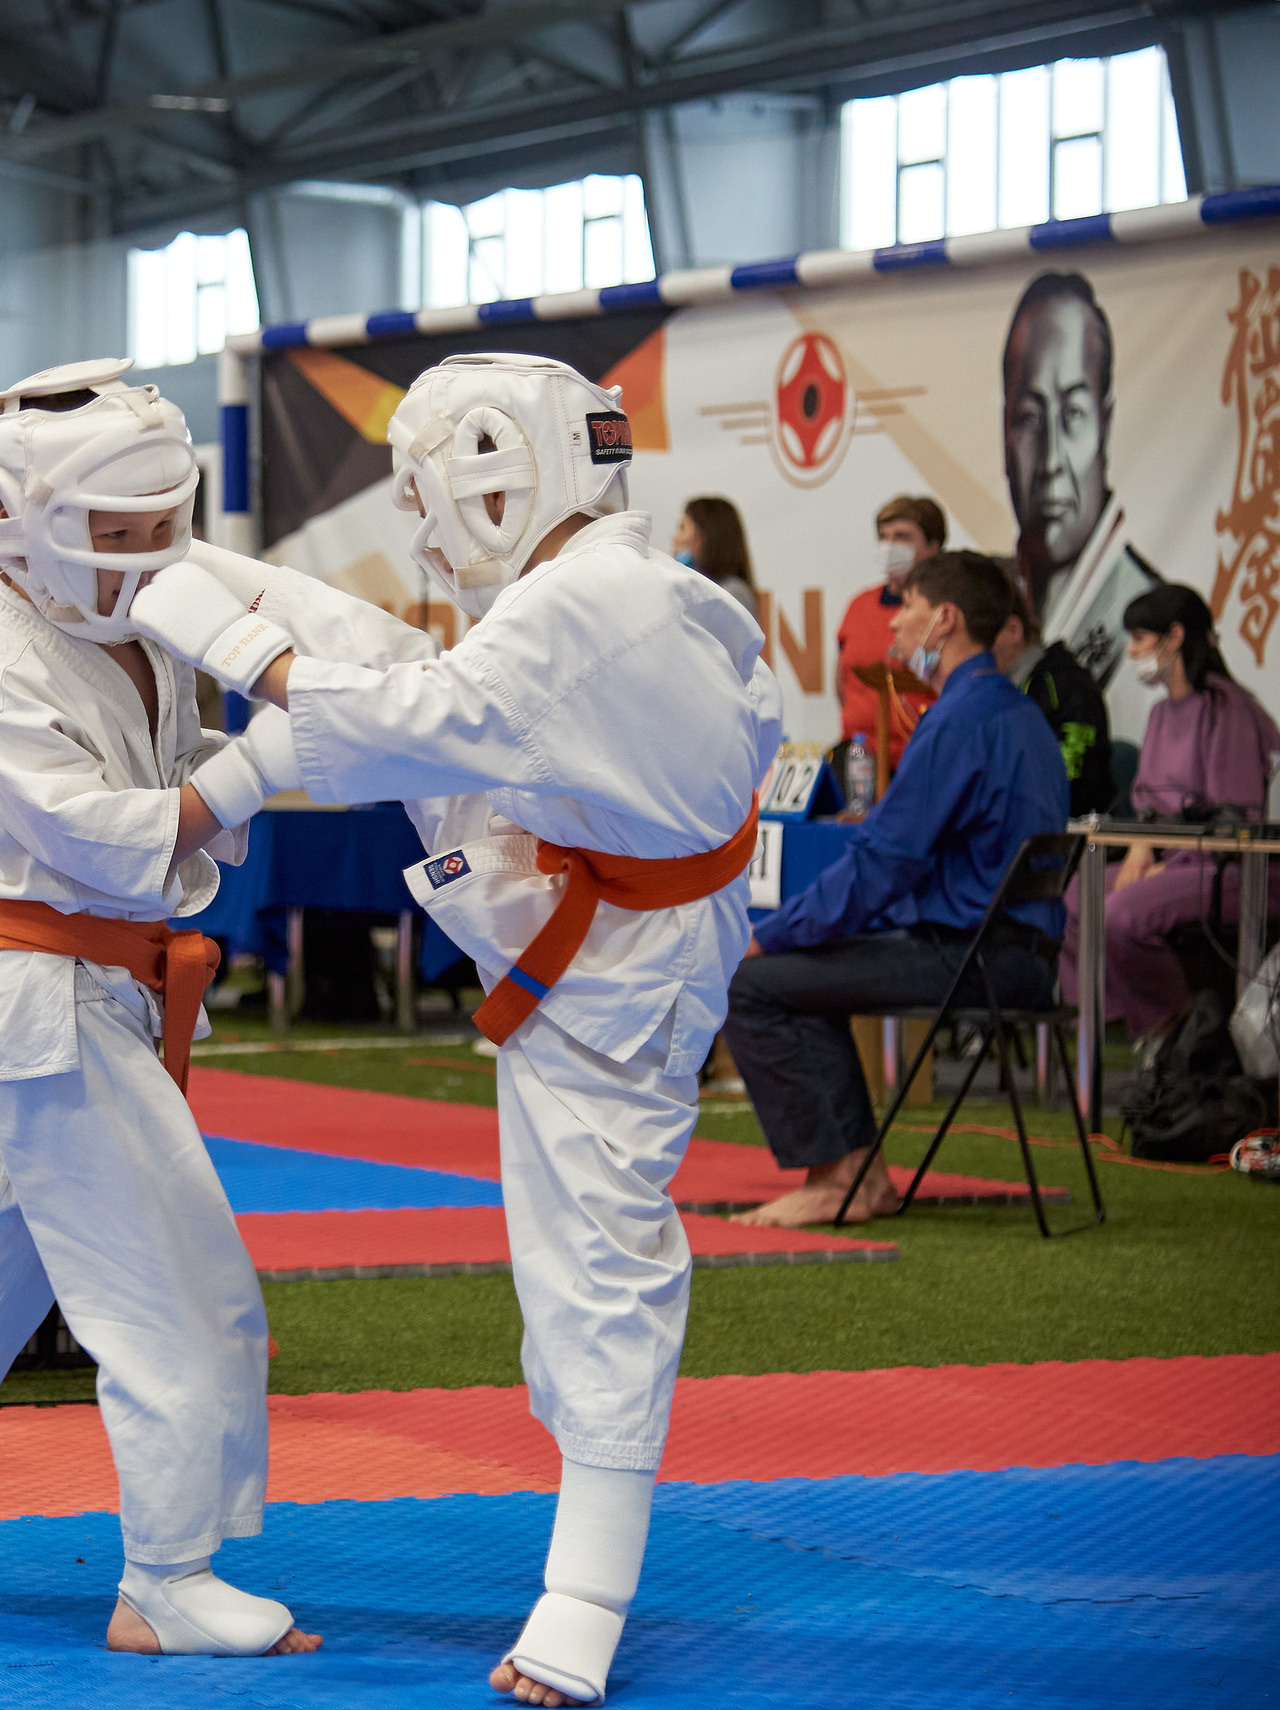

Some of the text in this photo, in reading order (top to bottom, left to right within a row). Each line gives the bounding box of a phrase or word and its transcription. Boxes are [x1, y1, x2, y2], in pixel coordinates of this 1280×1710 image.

[595, 448, 615, 456] SAFETY
[221, 623, 269, 667] TOP RANK
